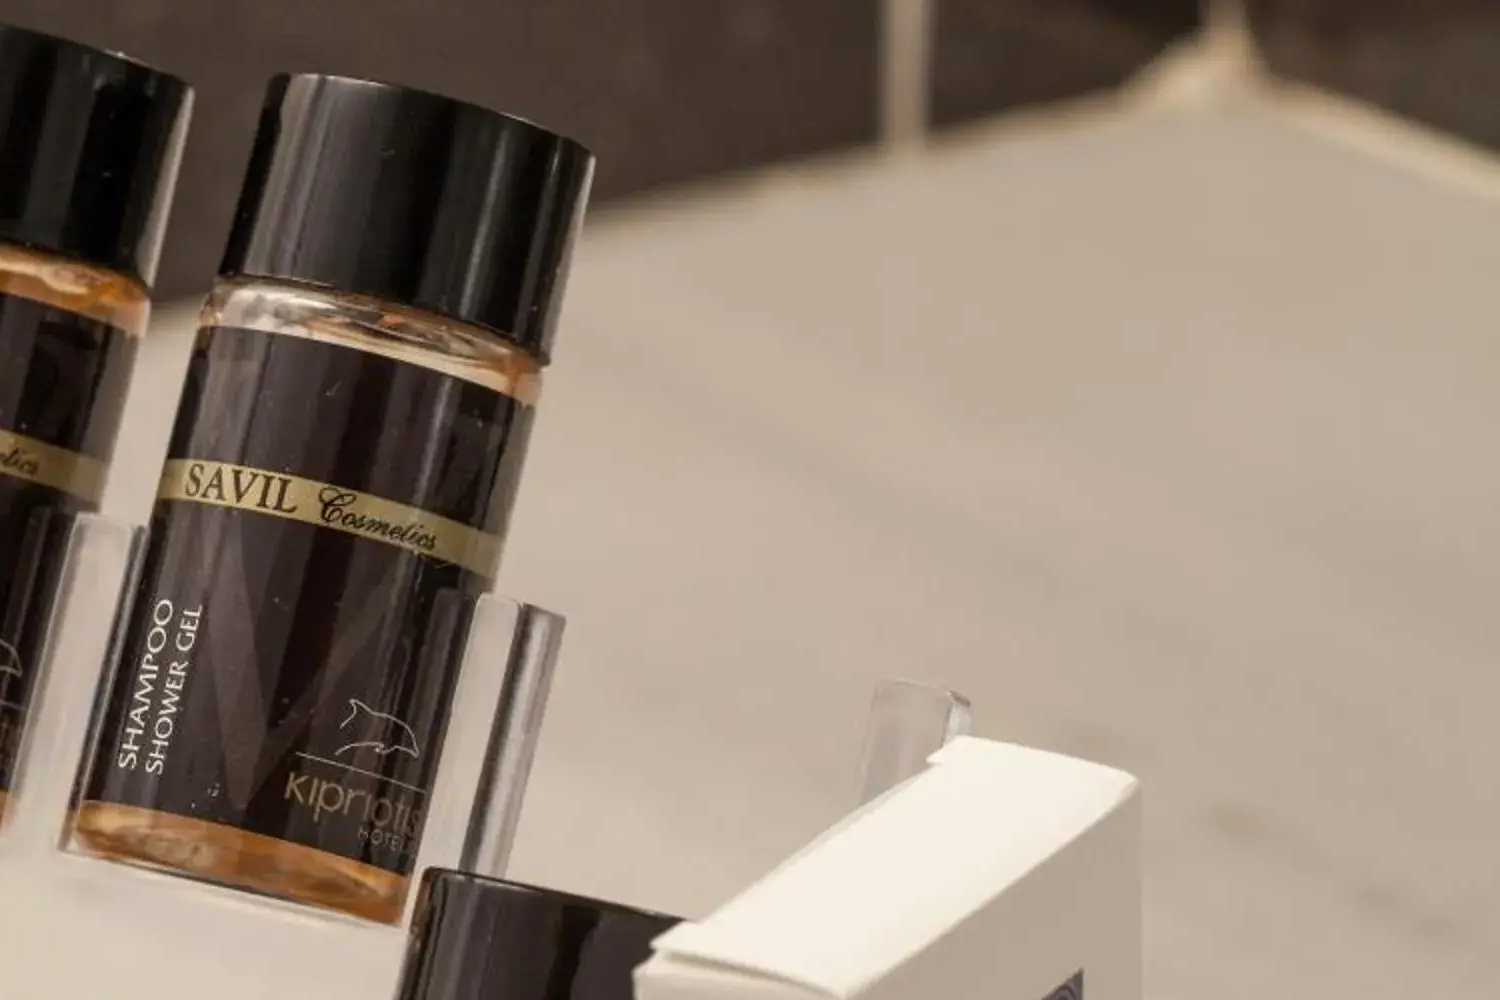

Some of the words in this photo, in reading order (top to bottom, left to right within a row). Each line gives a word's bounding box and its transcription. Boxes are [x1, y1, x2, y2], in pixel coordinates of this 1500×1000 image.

[184, 462, 299, 514] SAVIL
[317, 486, 438, 551] Cosmetics
[118, 598, 175, 769] SHAMPOO
[145, 658, 189, 775] SHOWER
[175, 604, 203, 653] GEL
